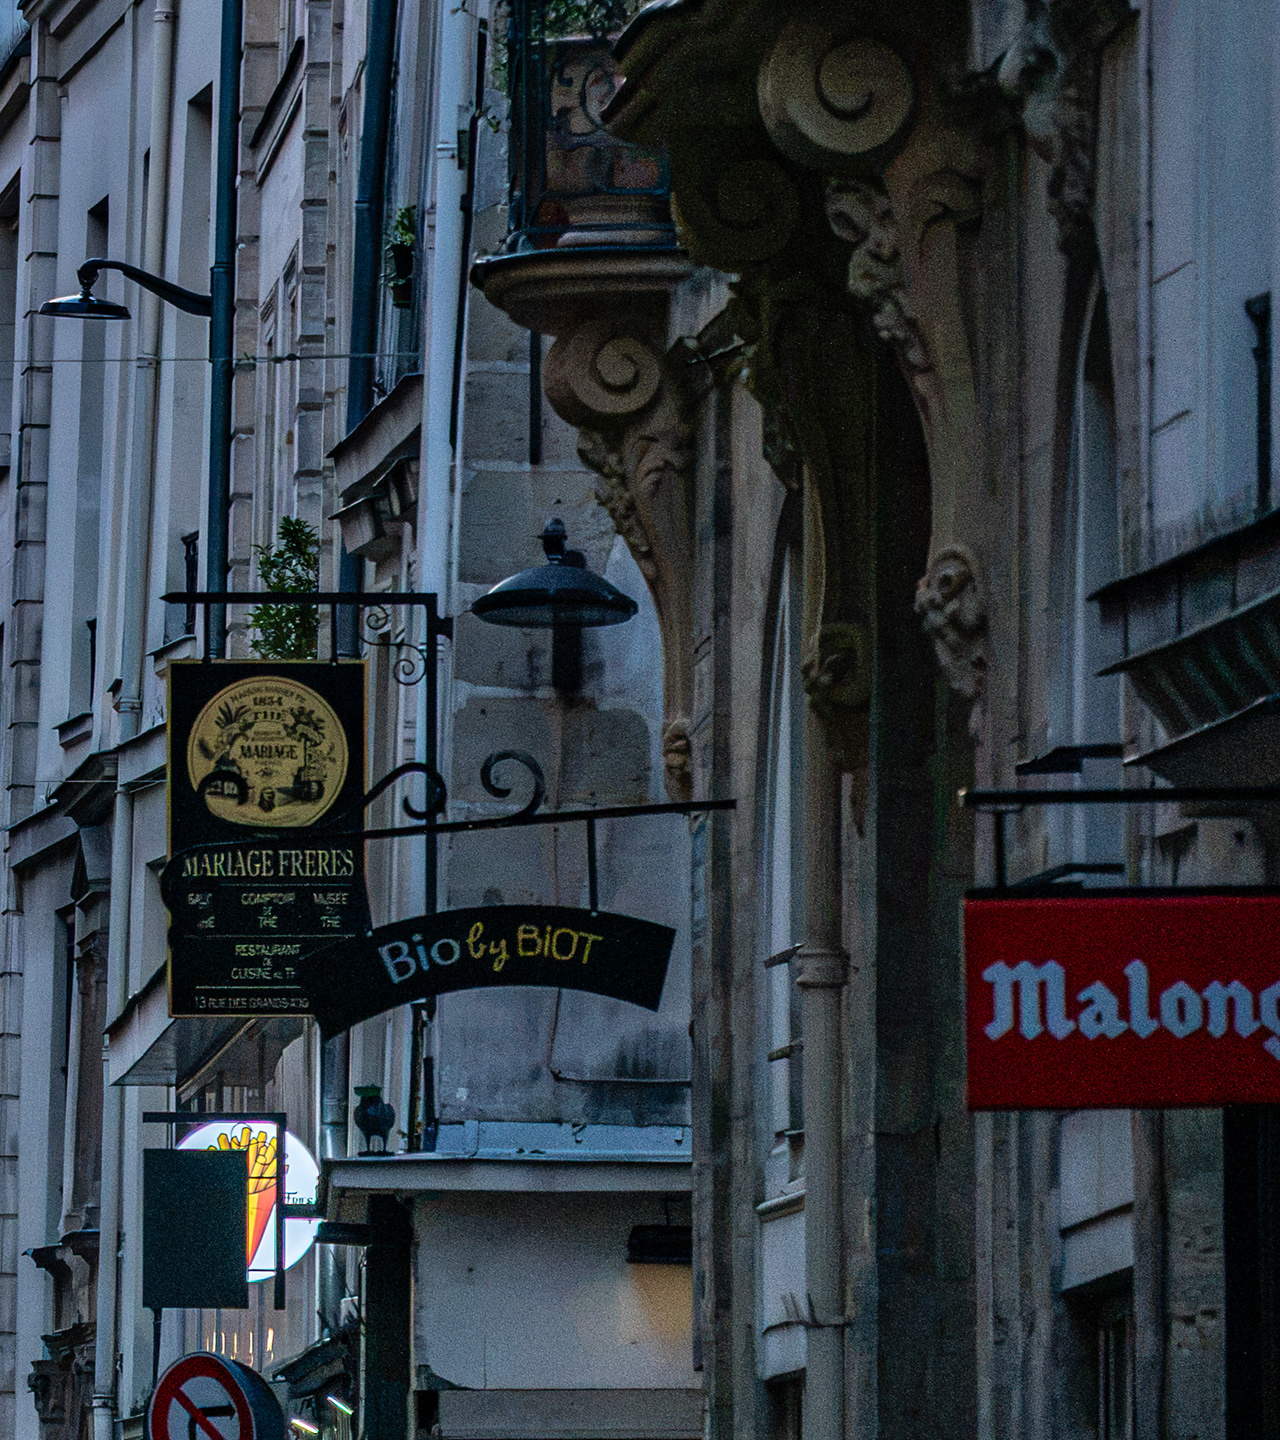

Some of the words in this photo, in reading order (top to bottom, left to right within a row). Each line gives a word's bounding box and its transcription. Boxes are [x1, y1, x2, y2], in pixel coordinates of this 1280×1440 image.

[182, 850, 274, 877] MARIAGE
[378, 933, 462, 985] Bio
[466, 921, 510, 972] by
